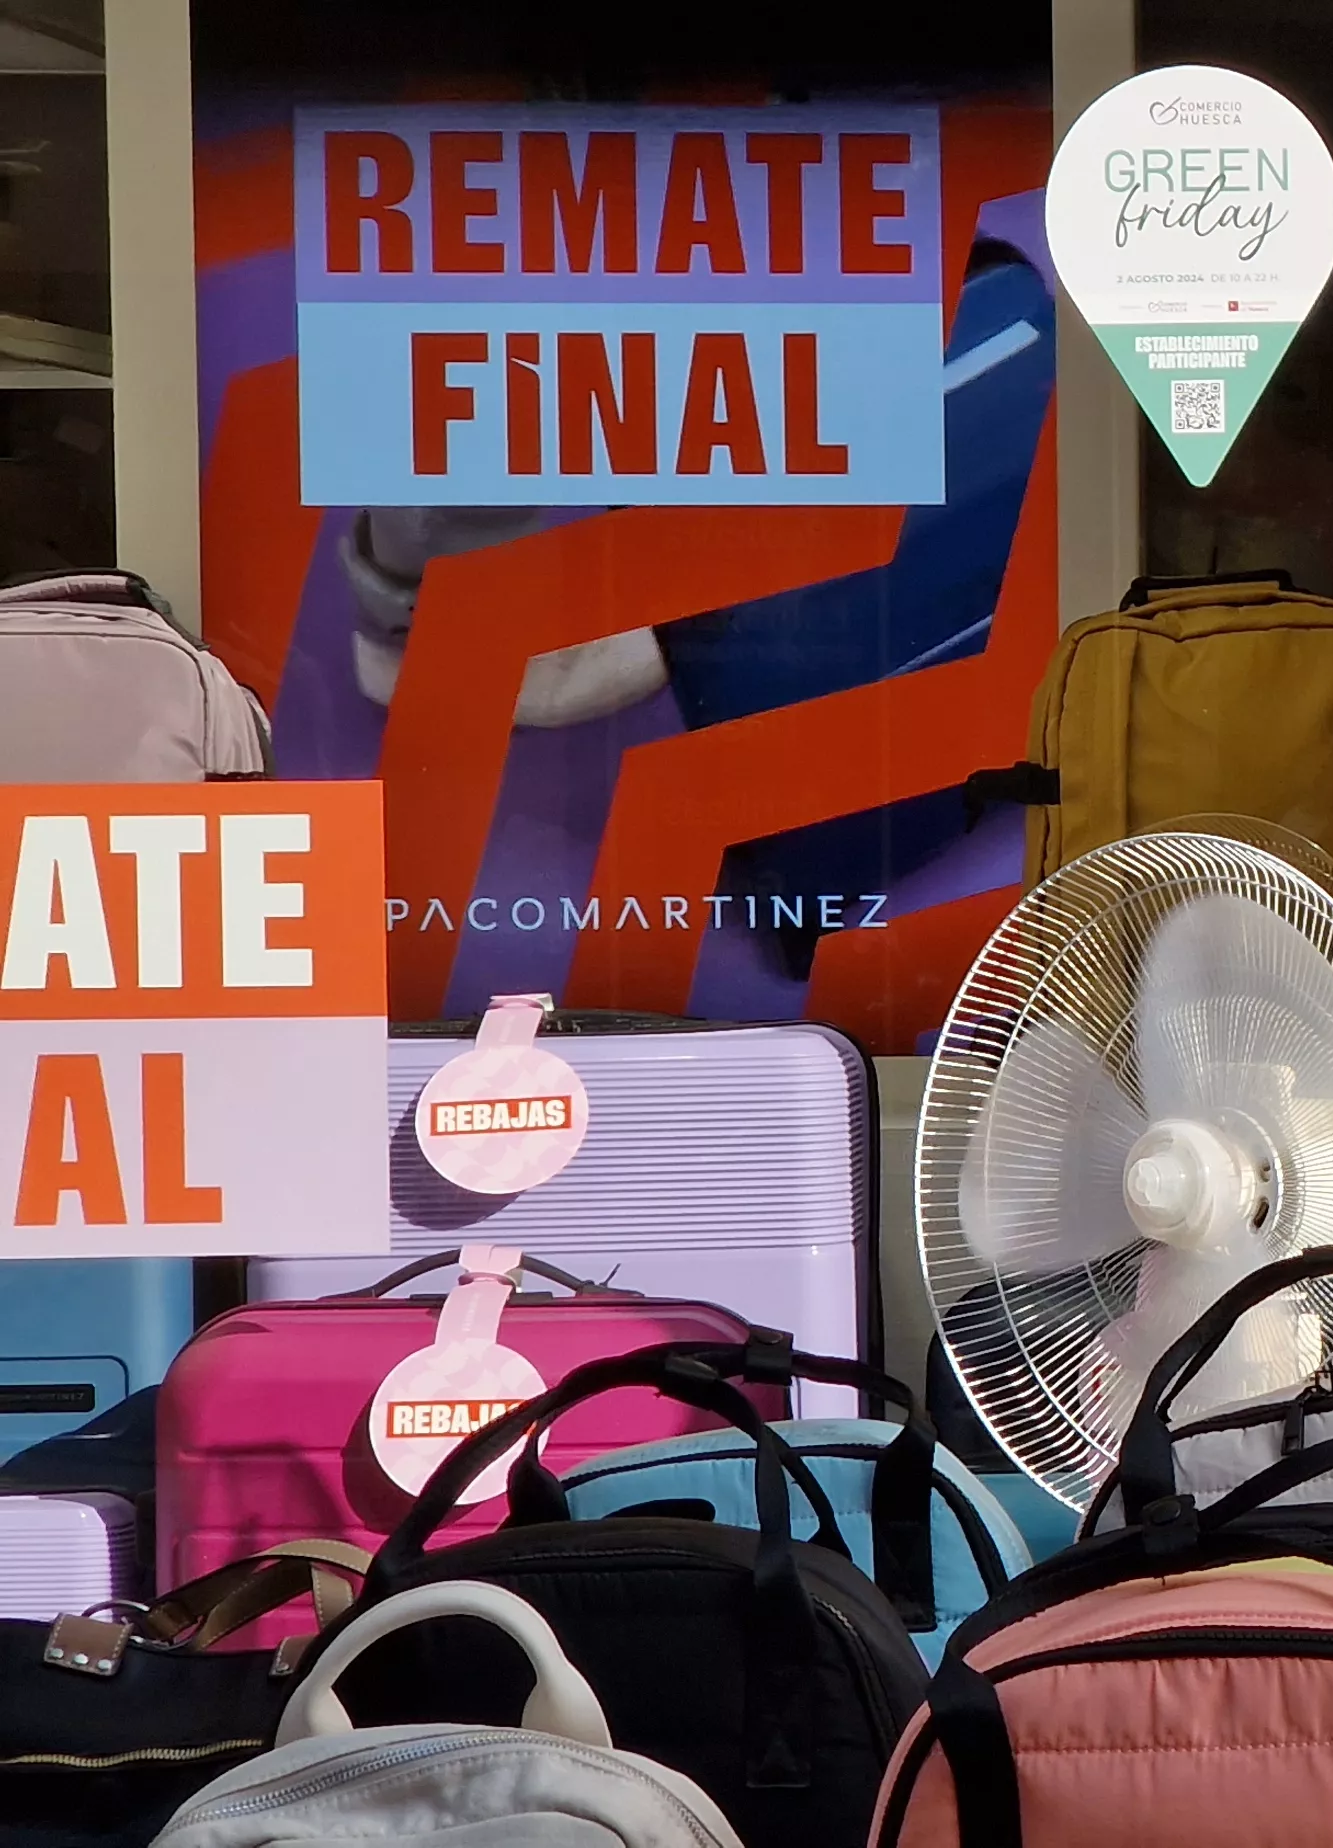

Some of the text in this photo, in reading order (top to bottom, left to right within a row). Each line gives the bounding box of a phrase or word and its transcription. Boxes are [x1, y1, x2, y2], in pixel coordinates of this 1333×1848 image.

[1180, 101, 1242, 111] COMERCIO
[1180, 114, 1242, 125] HUESCA
[1104, 148, 1288, 192] GREEN
[325, 131, 912, 274] REMATE
[1115, 173, 1289, 261] friday
[1126, 273, 1174, 284] AGOSTO
[1211, 273, 1226, 283] DE
[1244, 273, 1252, 283] A
[1135, 335, 1258, 352] ESTABLECIMIENTO
[1148, 352, 1246, 369] PARTICIPANTE
[411, 332, 849, 475] FINAL
[1, 813, 313, 989] ATE
[385, 895, 888, 931] PACOMARTINEZ
[436, 1099, 566, 1132] REBAJAS
[13, 1053, 223, 1225] AL
